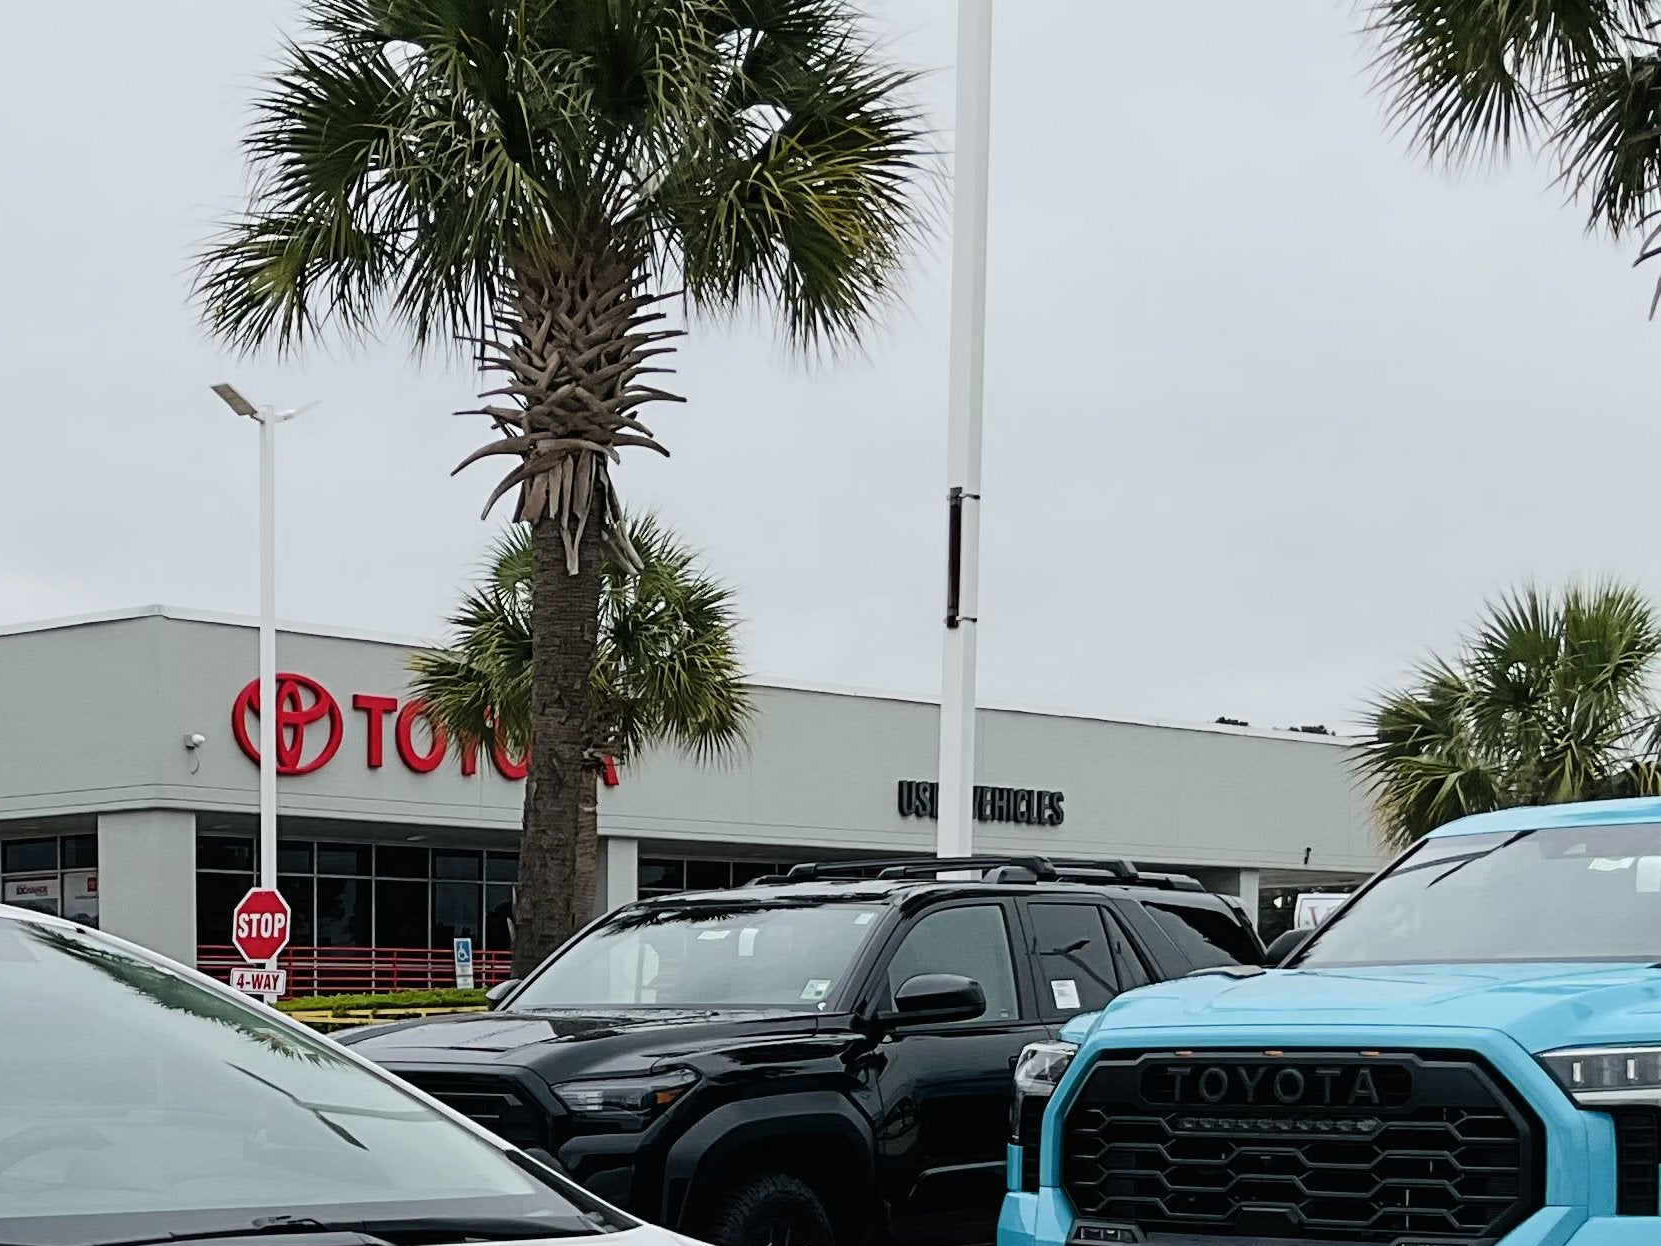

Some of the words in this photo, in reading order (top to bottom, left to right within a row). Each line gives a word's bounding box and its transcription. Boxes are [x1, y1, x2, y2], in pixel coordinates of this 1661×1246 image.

[898, 780, 939, 818] US
[237, 911, 286, 940] STOP
[235, 973, 280, 992] 4-WAY
[1166, 1066, 1381, 1105] TOYOTA
